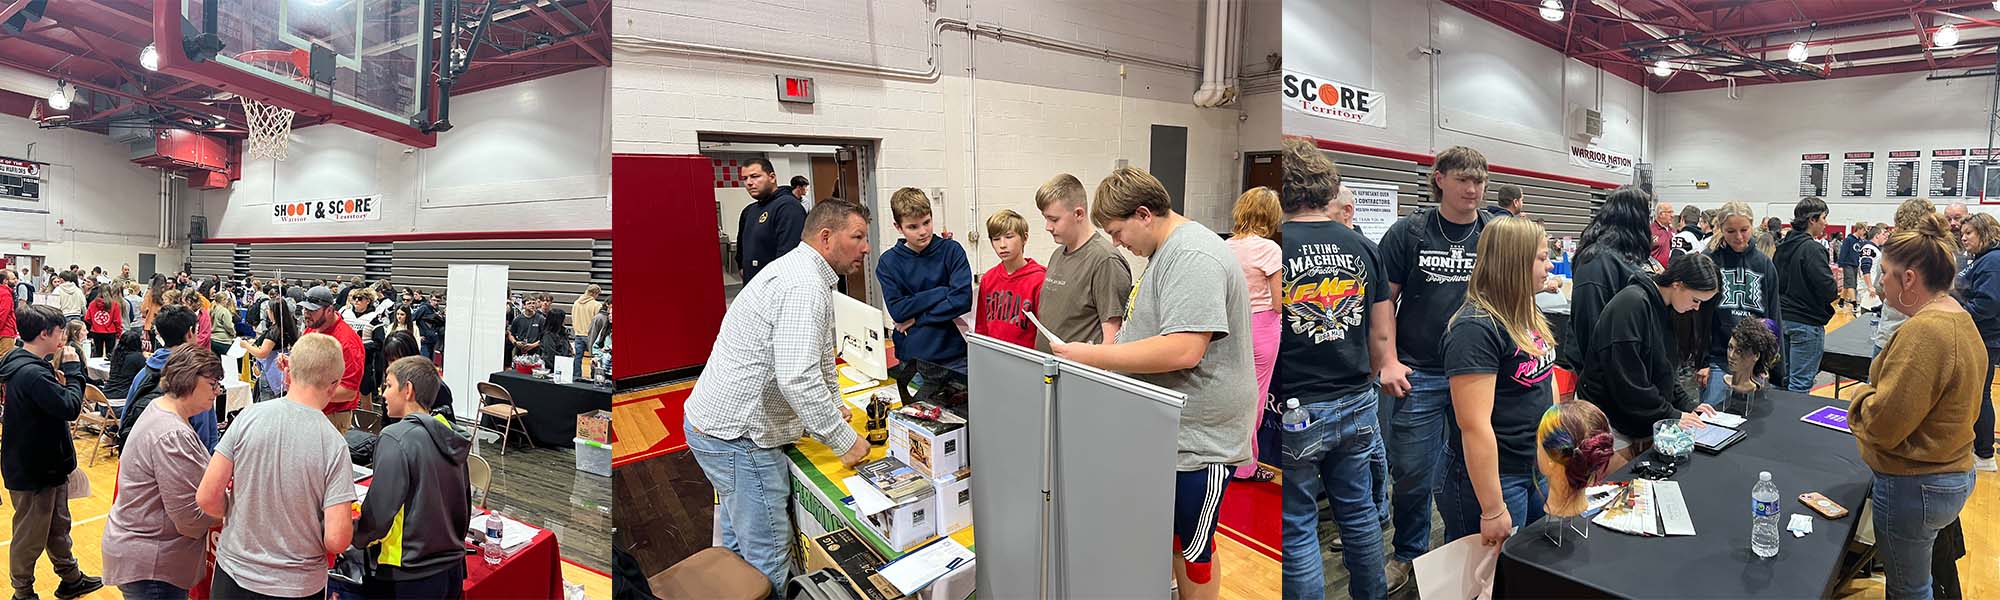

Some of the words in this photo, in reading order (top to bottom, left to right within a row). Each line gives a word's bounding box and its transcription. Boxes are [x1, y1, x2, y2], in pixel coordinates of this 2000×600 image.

[1283, 74, 1370, 113] SCORE
[1299, 99, 1364, 122] Territory
[1570, 146, 1607, 163] WARRIOR
[1607, 154, 1632, 168] NATION
[274, 202, 312, 217] SHOOT
[315, 201, 326, 219] &
[328, 198, 372, 215] SCORE
[1450, 250, 1463, 259] M
[1288, 254, 1356, 278] MACHINE
[1306, 265, 1341, 278] Factory
[1292, 276, 1357, 302] FMF
